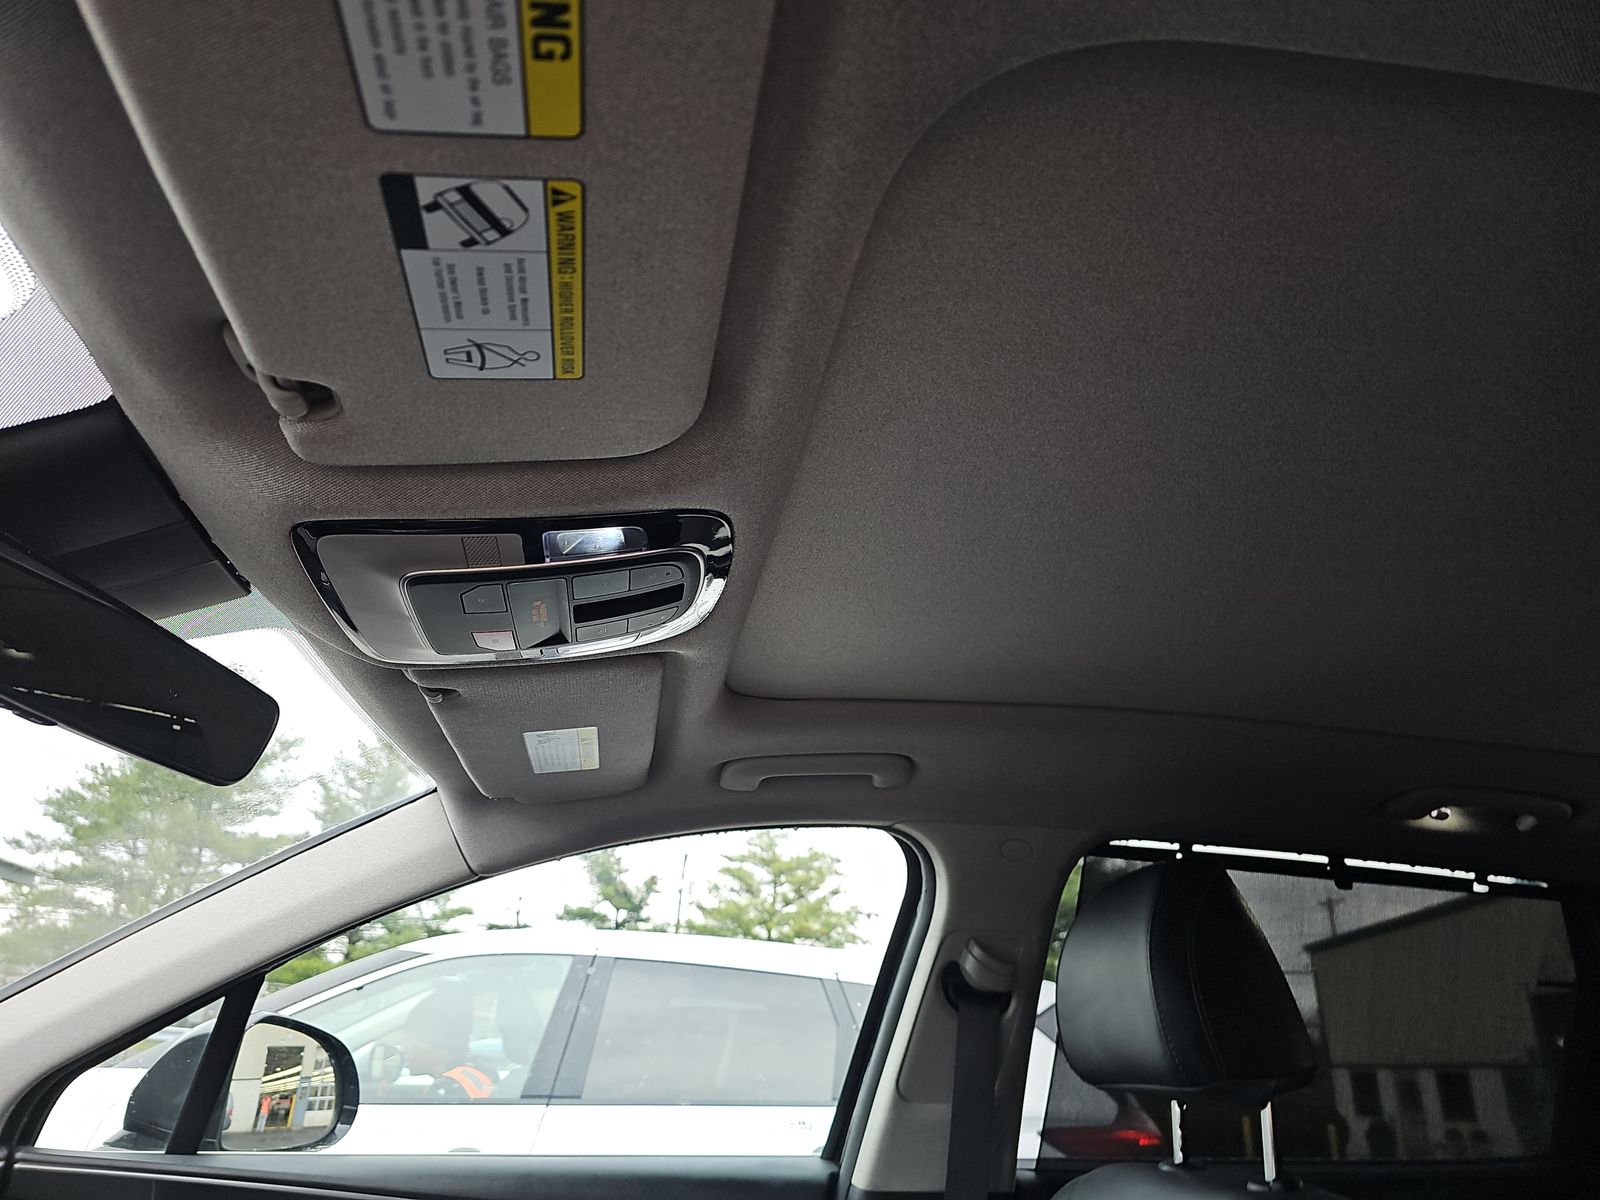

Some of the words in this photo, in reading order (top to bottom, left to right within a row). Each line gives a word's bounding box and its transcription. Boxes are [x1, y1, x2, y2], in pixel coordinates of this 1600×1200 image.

[558, 281, 575, 313] HIGHER
[559, 316, 576, 356] ROLLOVER
[560, 358, 576, 375] RISK
